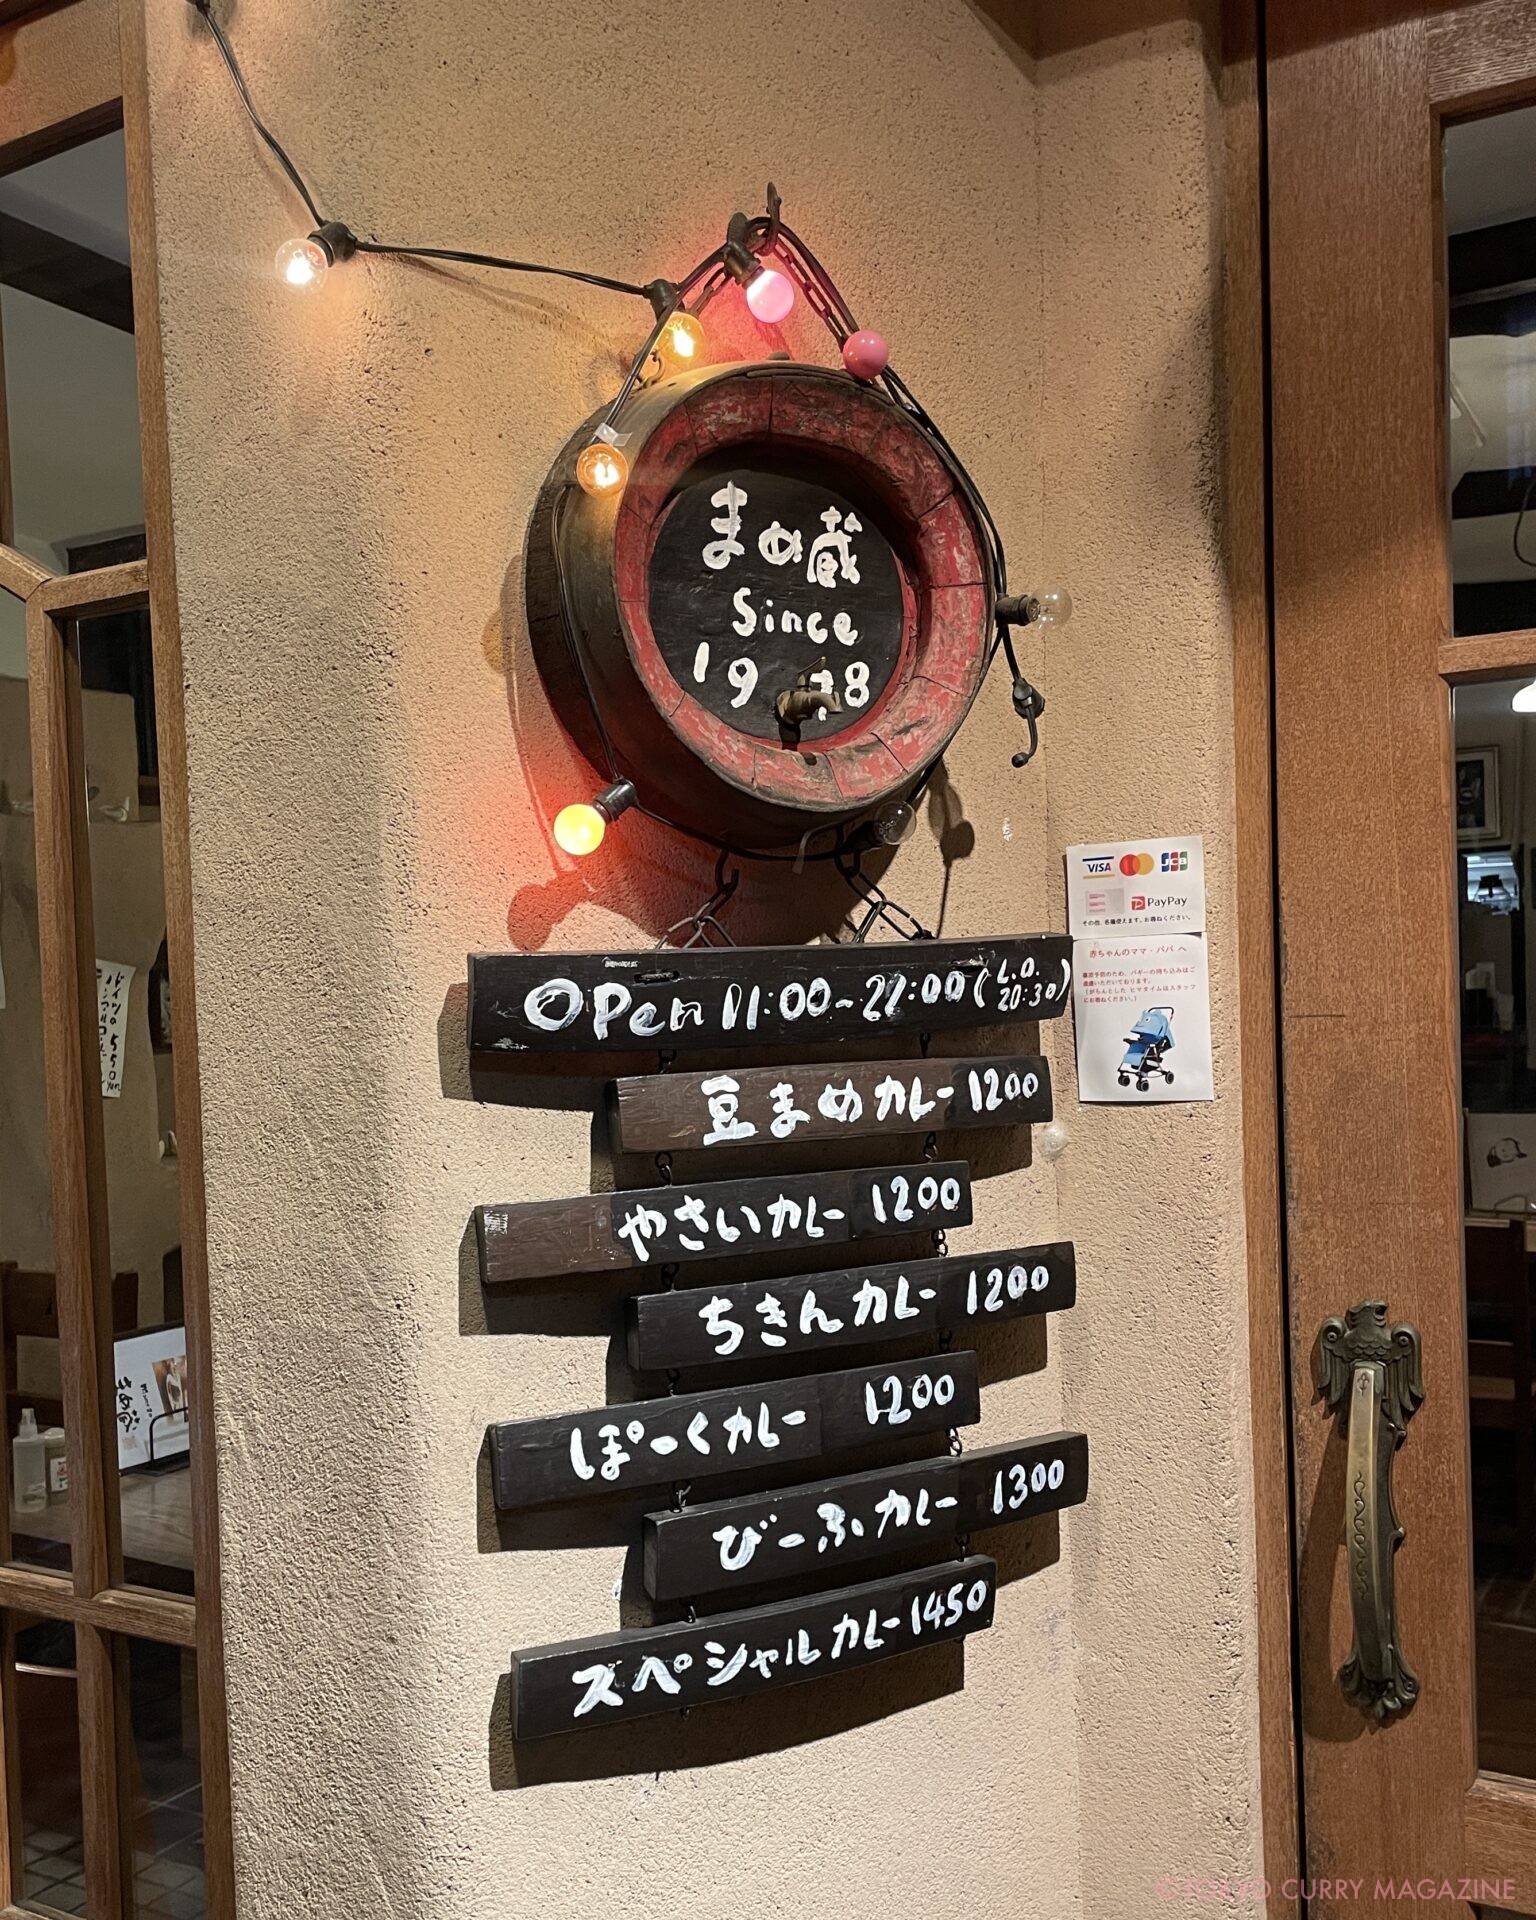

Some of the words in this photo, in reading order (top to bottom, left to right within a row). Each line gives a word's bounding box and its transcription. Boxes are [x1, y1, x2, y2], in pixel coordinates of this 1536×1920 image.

[732, 587, 858, 646] Since
[1087, 862, 1112, 873] VISA
[1161, 851, 1189, 872] JCB
[1147, 896, 1188, 908] PayPay
[969, 1068, 1039, 1112] 1200
[618, 1194, 844, 1262] やさいカレー
[872, 1176, 960, 1223] 1200
[699, 1275, 936, 1355] ちきんカレー
[967, 1266, 1049, 1315] 1200
[570, 1402, 806, 1480] ぽーくカレー
[865, 1374, 955, 1424] 1200
[713, 1489, 957, 1570] びーふカレー
[993, 1459, 1065, 1515] 1300
[572, 1613, 900, 1718] スペシャルカレー
[911, 1580, 987, 1636] 1450
